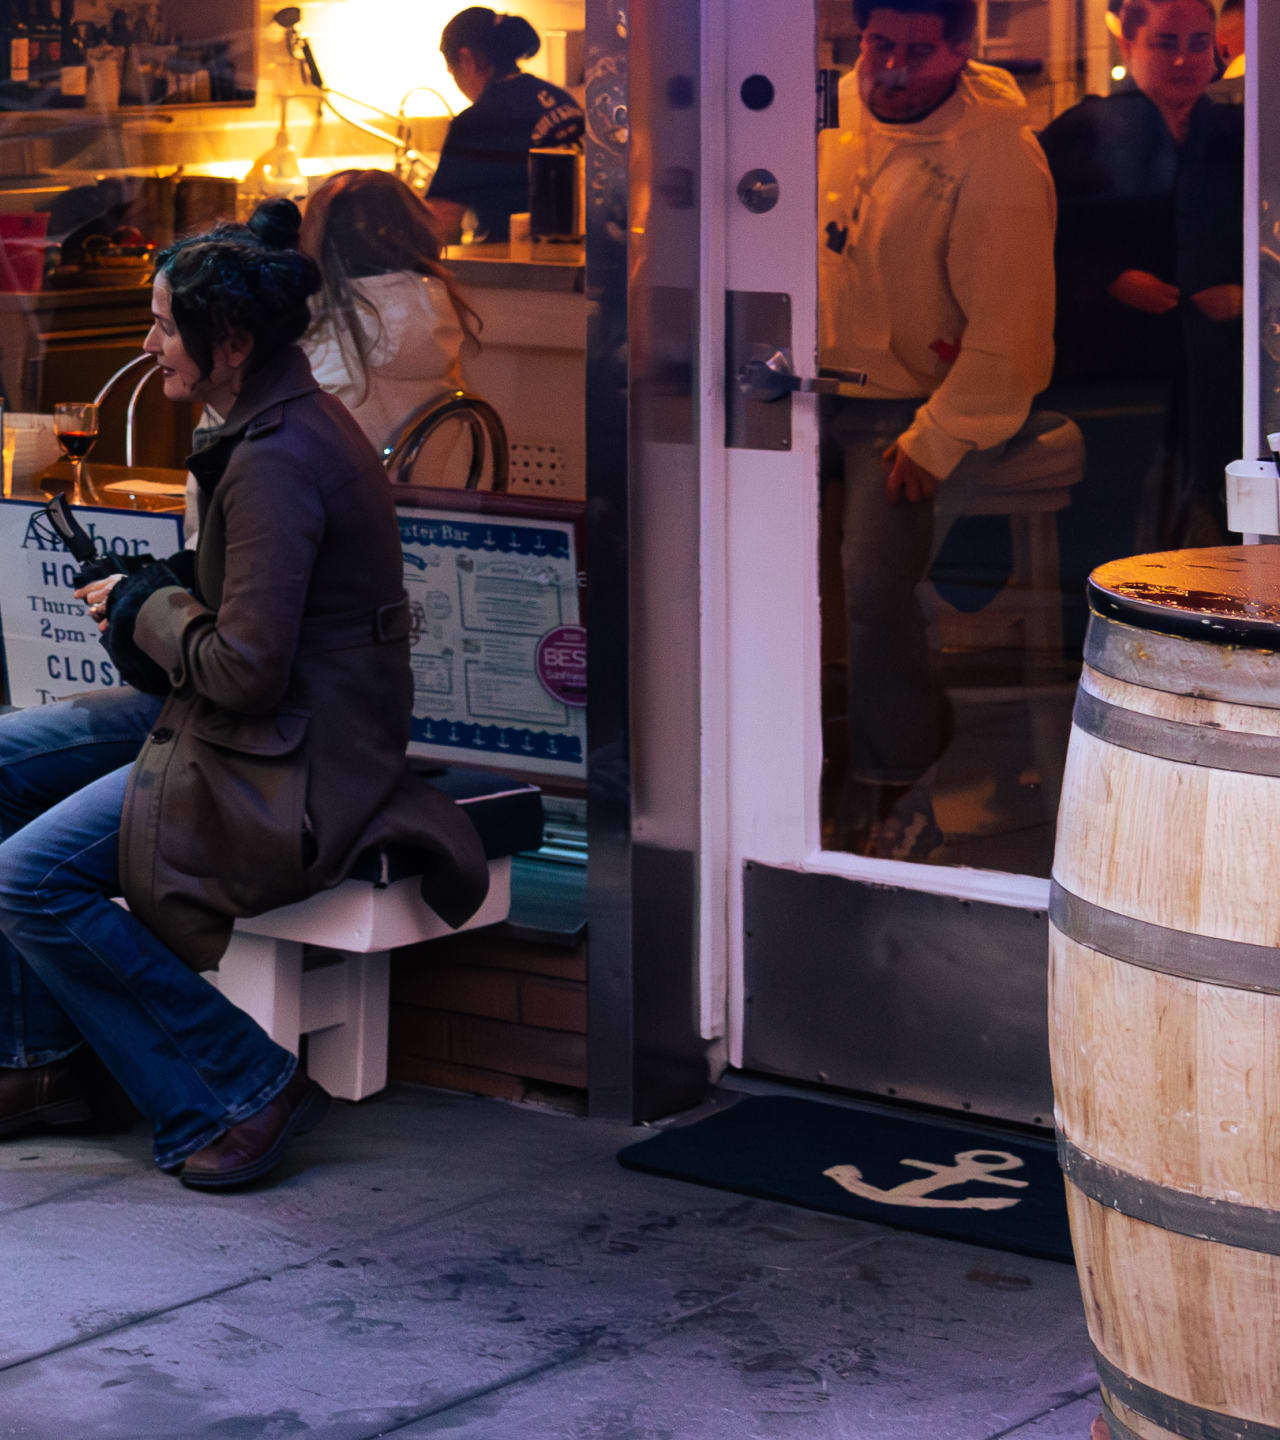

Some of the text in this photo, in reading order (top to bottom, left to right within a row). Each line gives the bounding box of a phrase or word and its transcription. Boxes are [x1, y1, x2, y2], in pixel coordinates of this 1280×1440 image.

[21, 514, 150, 557] Anhor
[441, 525, 471, 542] Bar
[40, 618, 86, 643] 2pm
[544, 647, 586, 668] BES
[47, 654, 128, 687] CLOS
